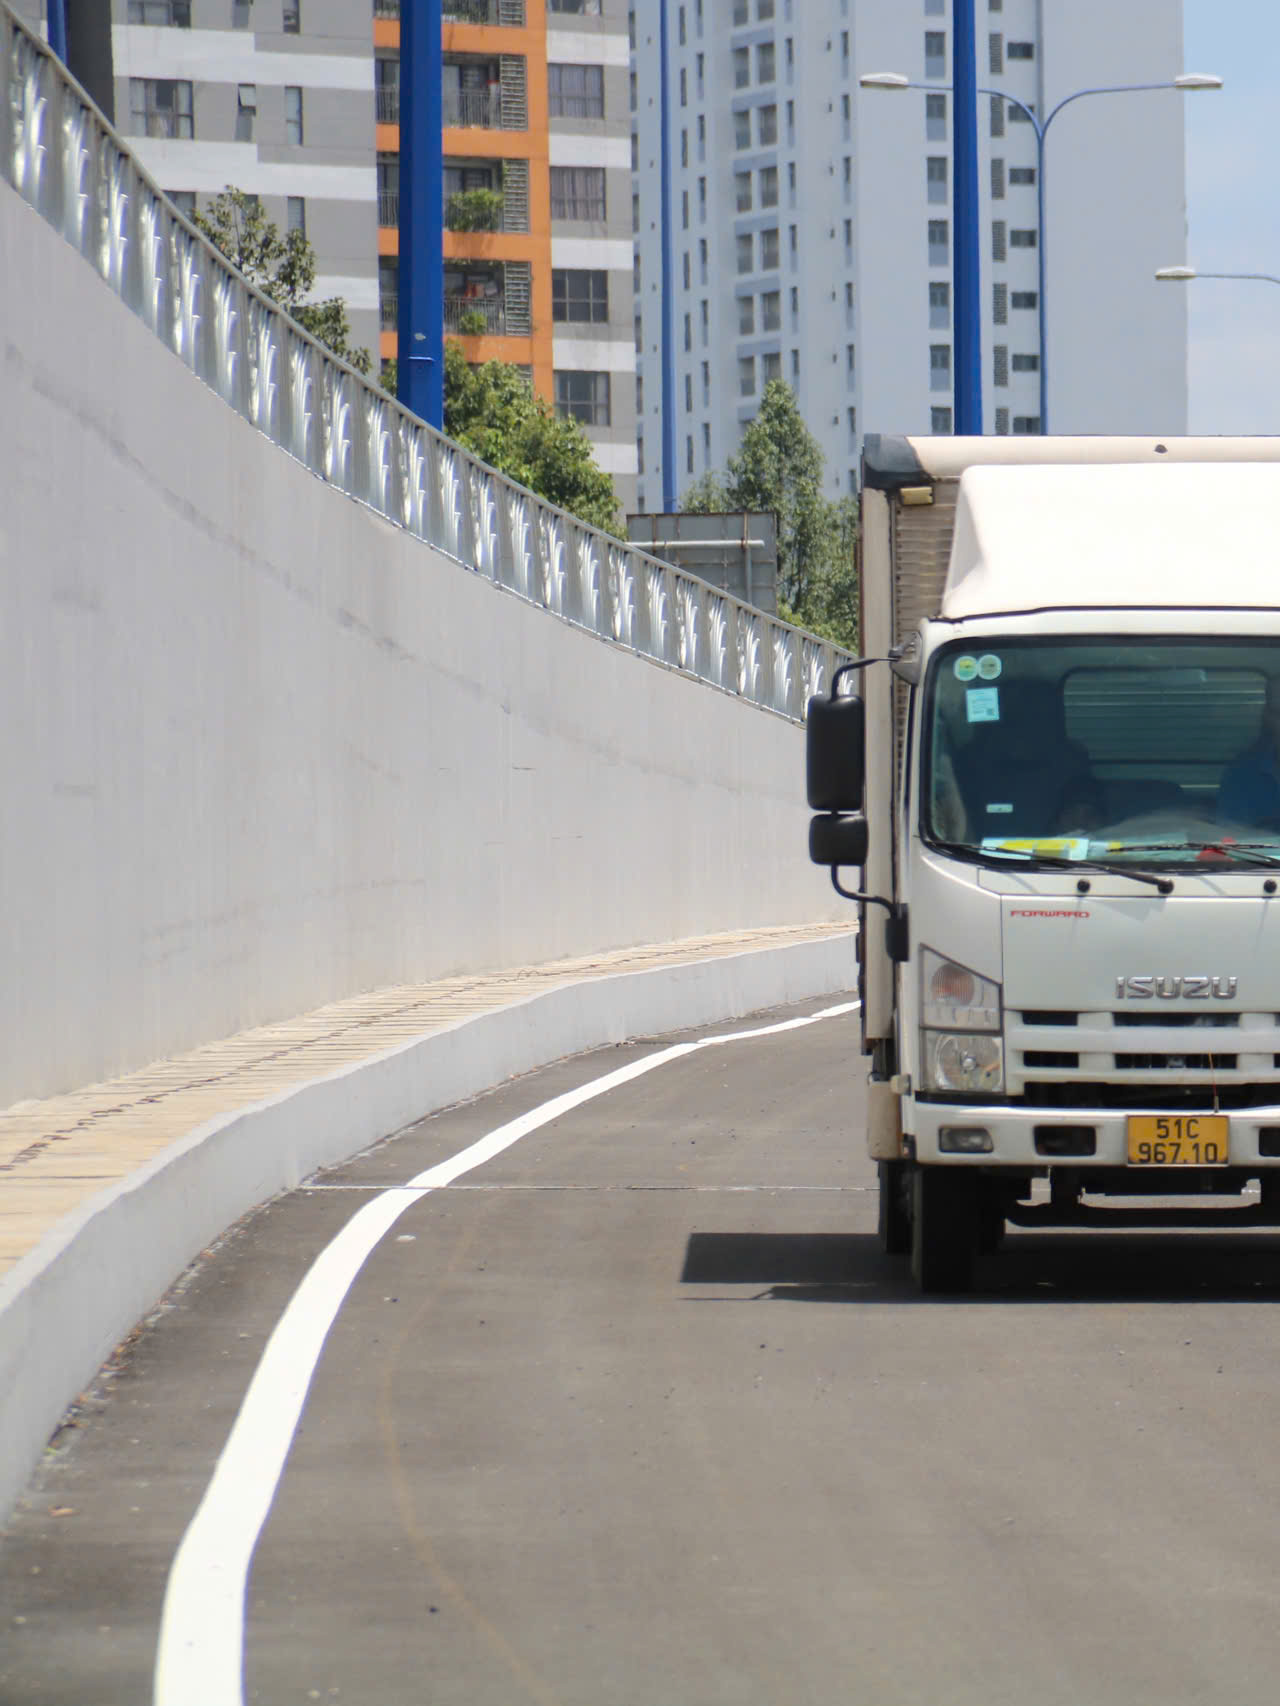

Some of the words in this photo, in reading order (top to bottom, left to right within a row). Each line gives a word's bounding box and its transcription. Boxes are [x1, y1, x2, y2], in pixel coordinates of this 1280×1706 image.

[1010, 909, 1090, 919] FORWARD
[1116, 976, 1238, 1000] ISUZU
[1156, 1118, 1199, 1139] 51C
[1138, 1142, 1218, 1164] 967.10
